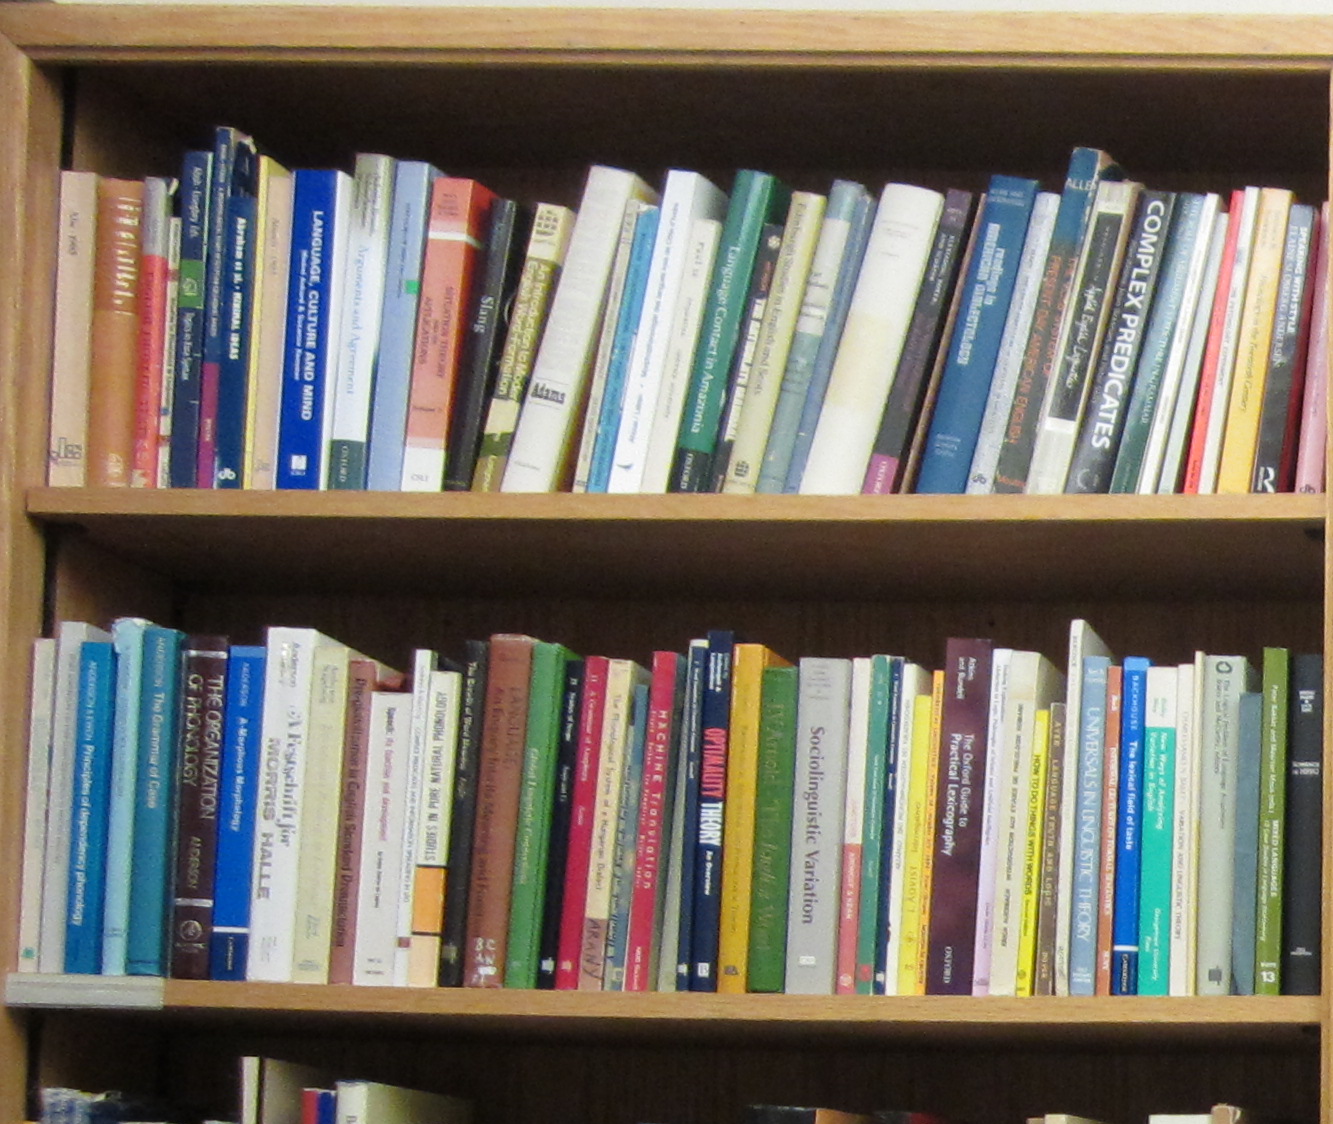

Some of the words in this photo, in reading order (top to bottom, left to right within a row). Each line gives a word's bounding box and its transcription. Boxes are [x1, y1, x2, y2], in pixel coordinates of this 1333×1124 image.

[308, 211, 324, 286] LANGUAGE,
[715, 245, 741, 305] Language
[1122, 200, 1166, 308] COMPLEX
[305, 291, 321, 349] CULTURE
[473, 295, 493, 333] Slang
[705, 308, 727, 354] Contact
[303, 353, 316, 381] AND
[704, 355, 718, 368] in
[1090, 313, 1138, 449] PREDICATES
[301, 385, 314, 421] MIND
[690, 371, 714, 434] Amazonia
[262, 738, 281, 821] MORRIS
[701, 728, 726, 798] OPTIMALITY
[804, 725, 825, 844] Sociolinguistic
[947, 734, 962, 781] Practical
[699, 802, 723, 846] THEORY
[940, 784, 960, 856] Lexicography
[257, 832, 277, 900] HALLE
[801, 849, 820, 925] Variation
